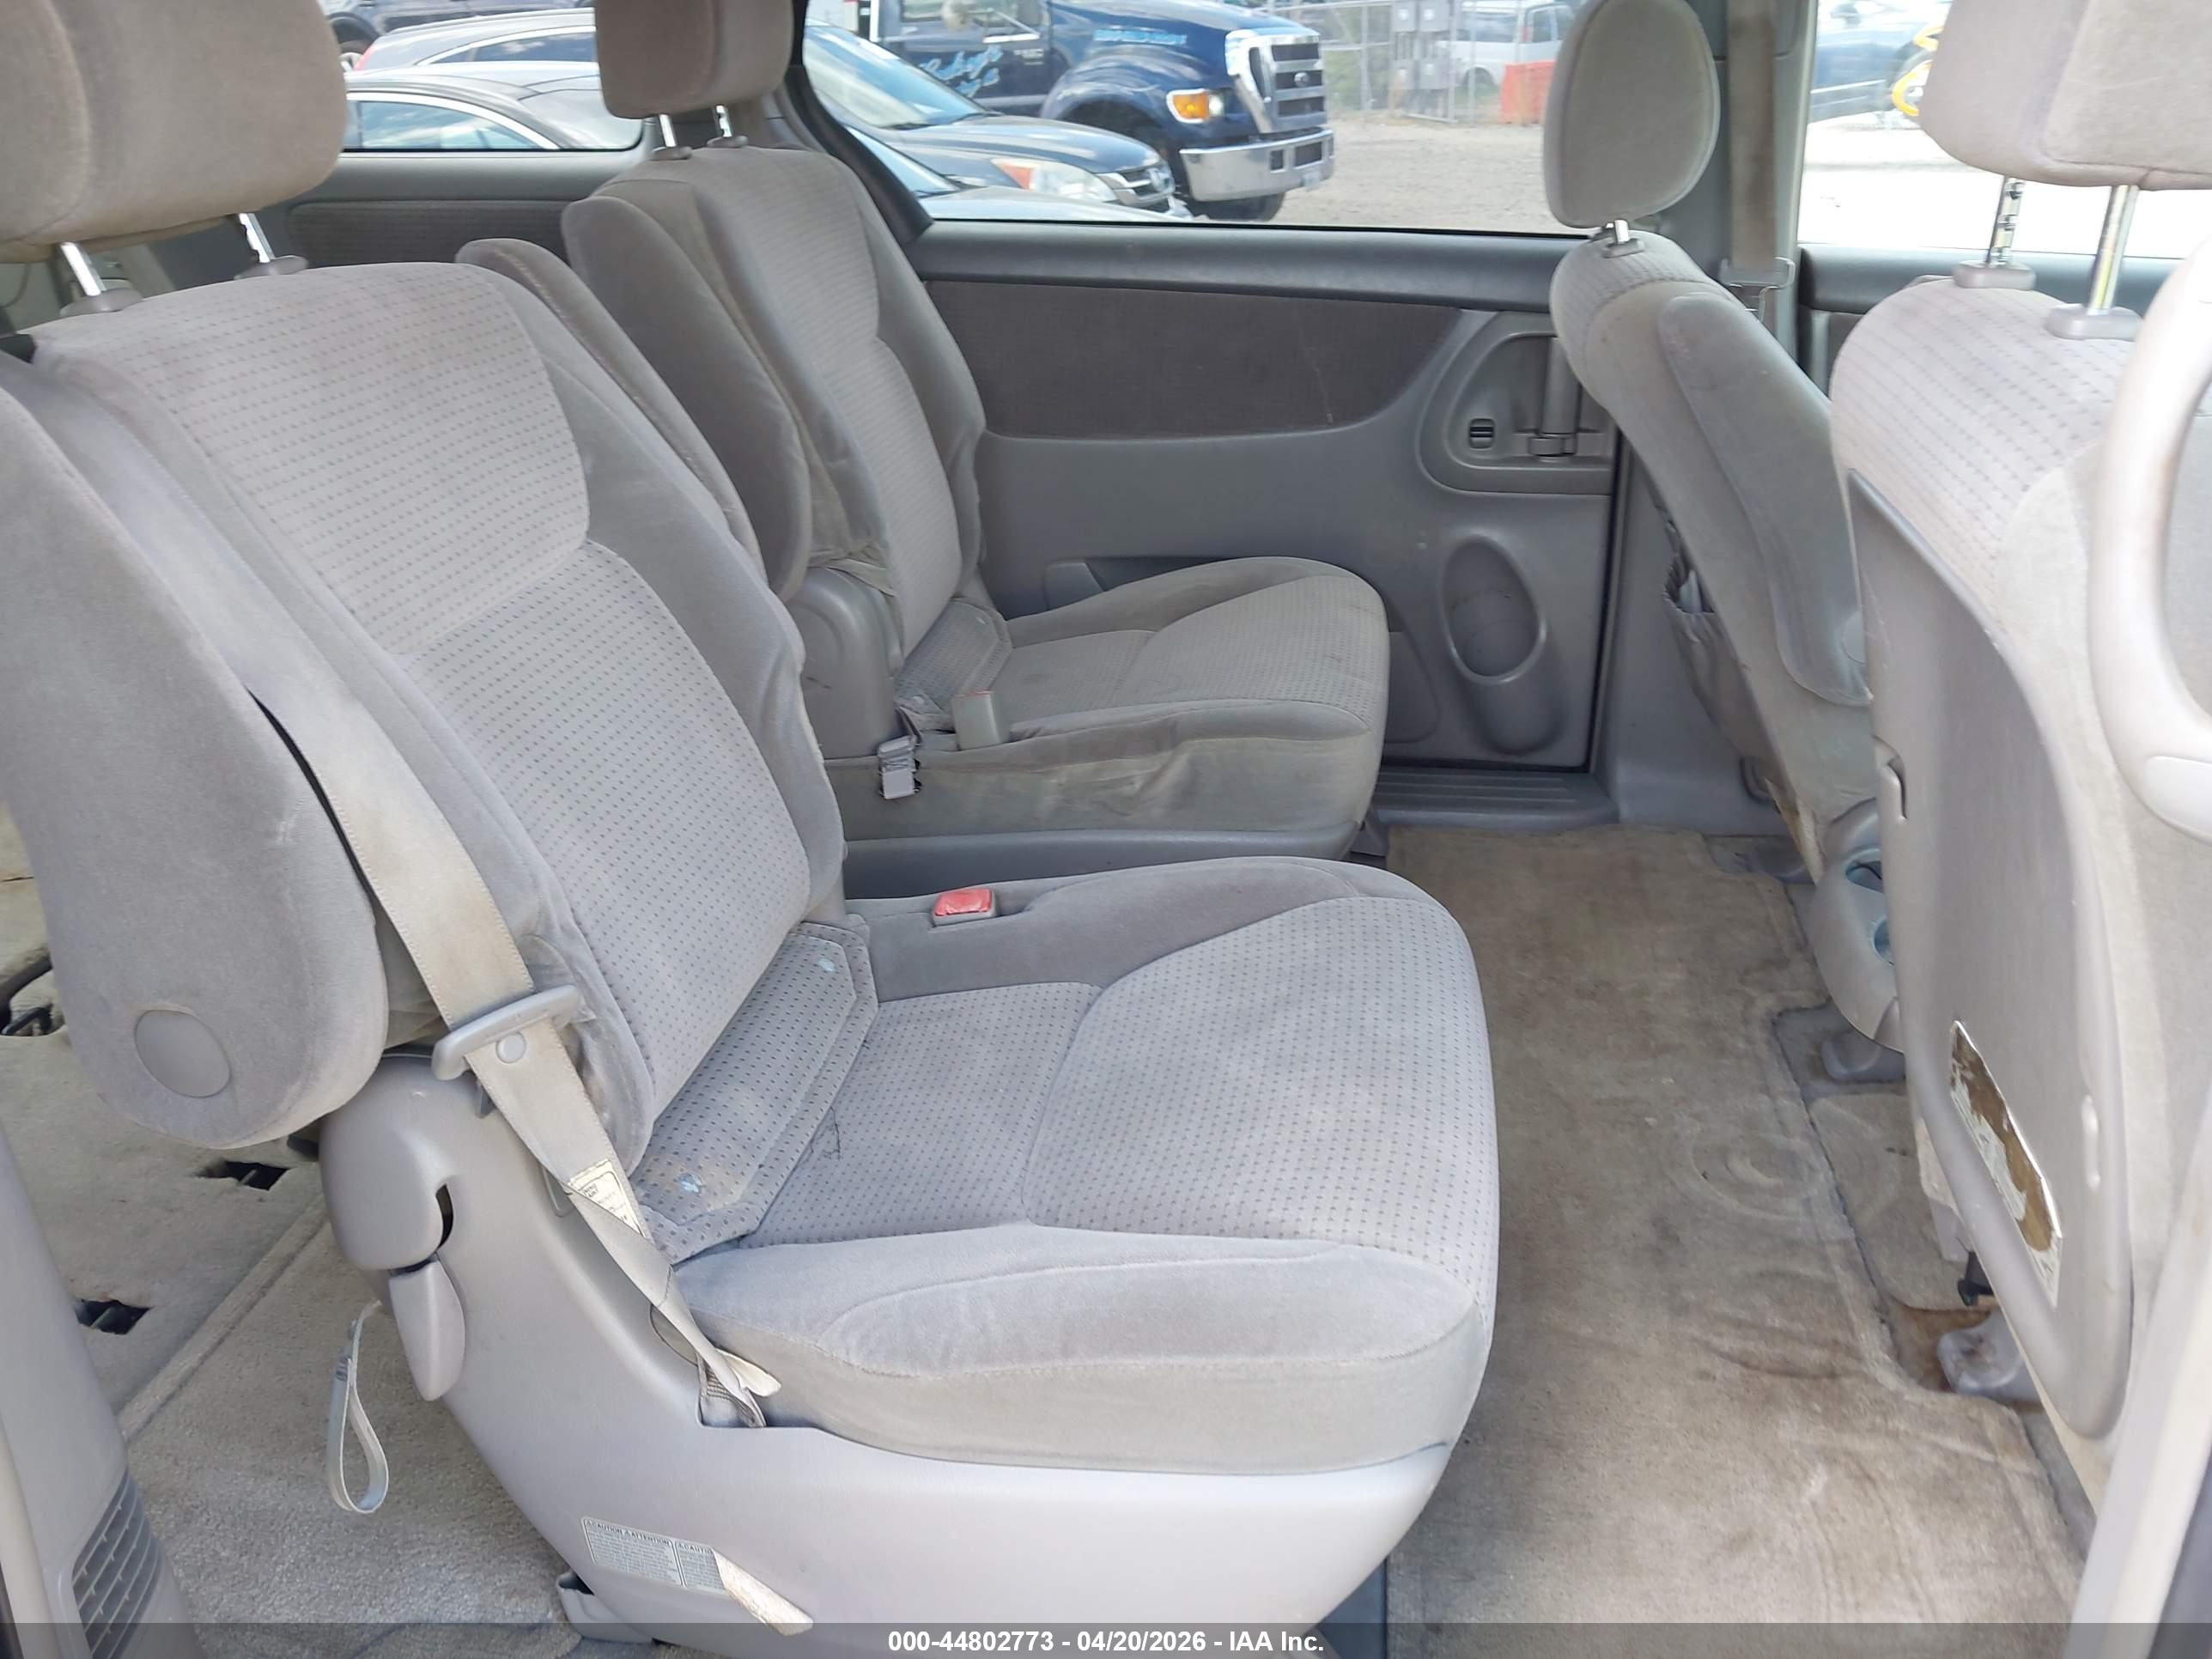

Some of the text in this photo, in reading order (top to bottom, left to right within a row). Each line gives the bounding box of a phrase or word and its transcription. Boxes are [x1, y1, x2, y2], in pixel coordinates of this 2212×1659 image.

[592, 1522, 670, 1545] CAUTION ATTENTION
[684, 1544, 714, 1554] CAUTIO
